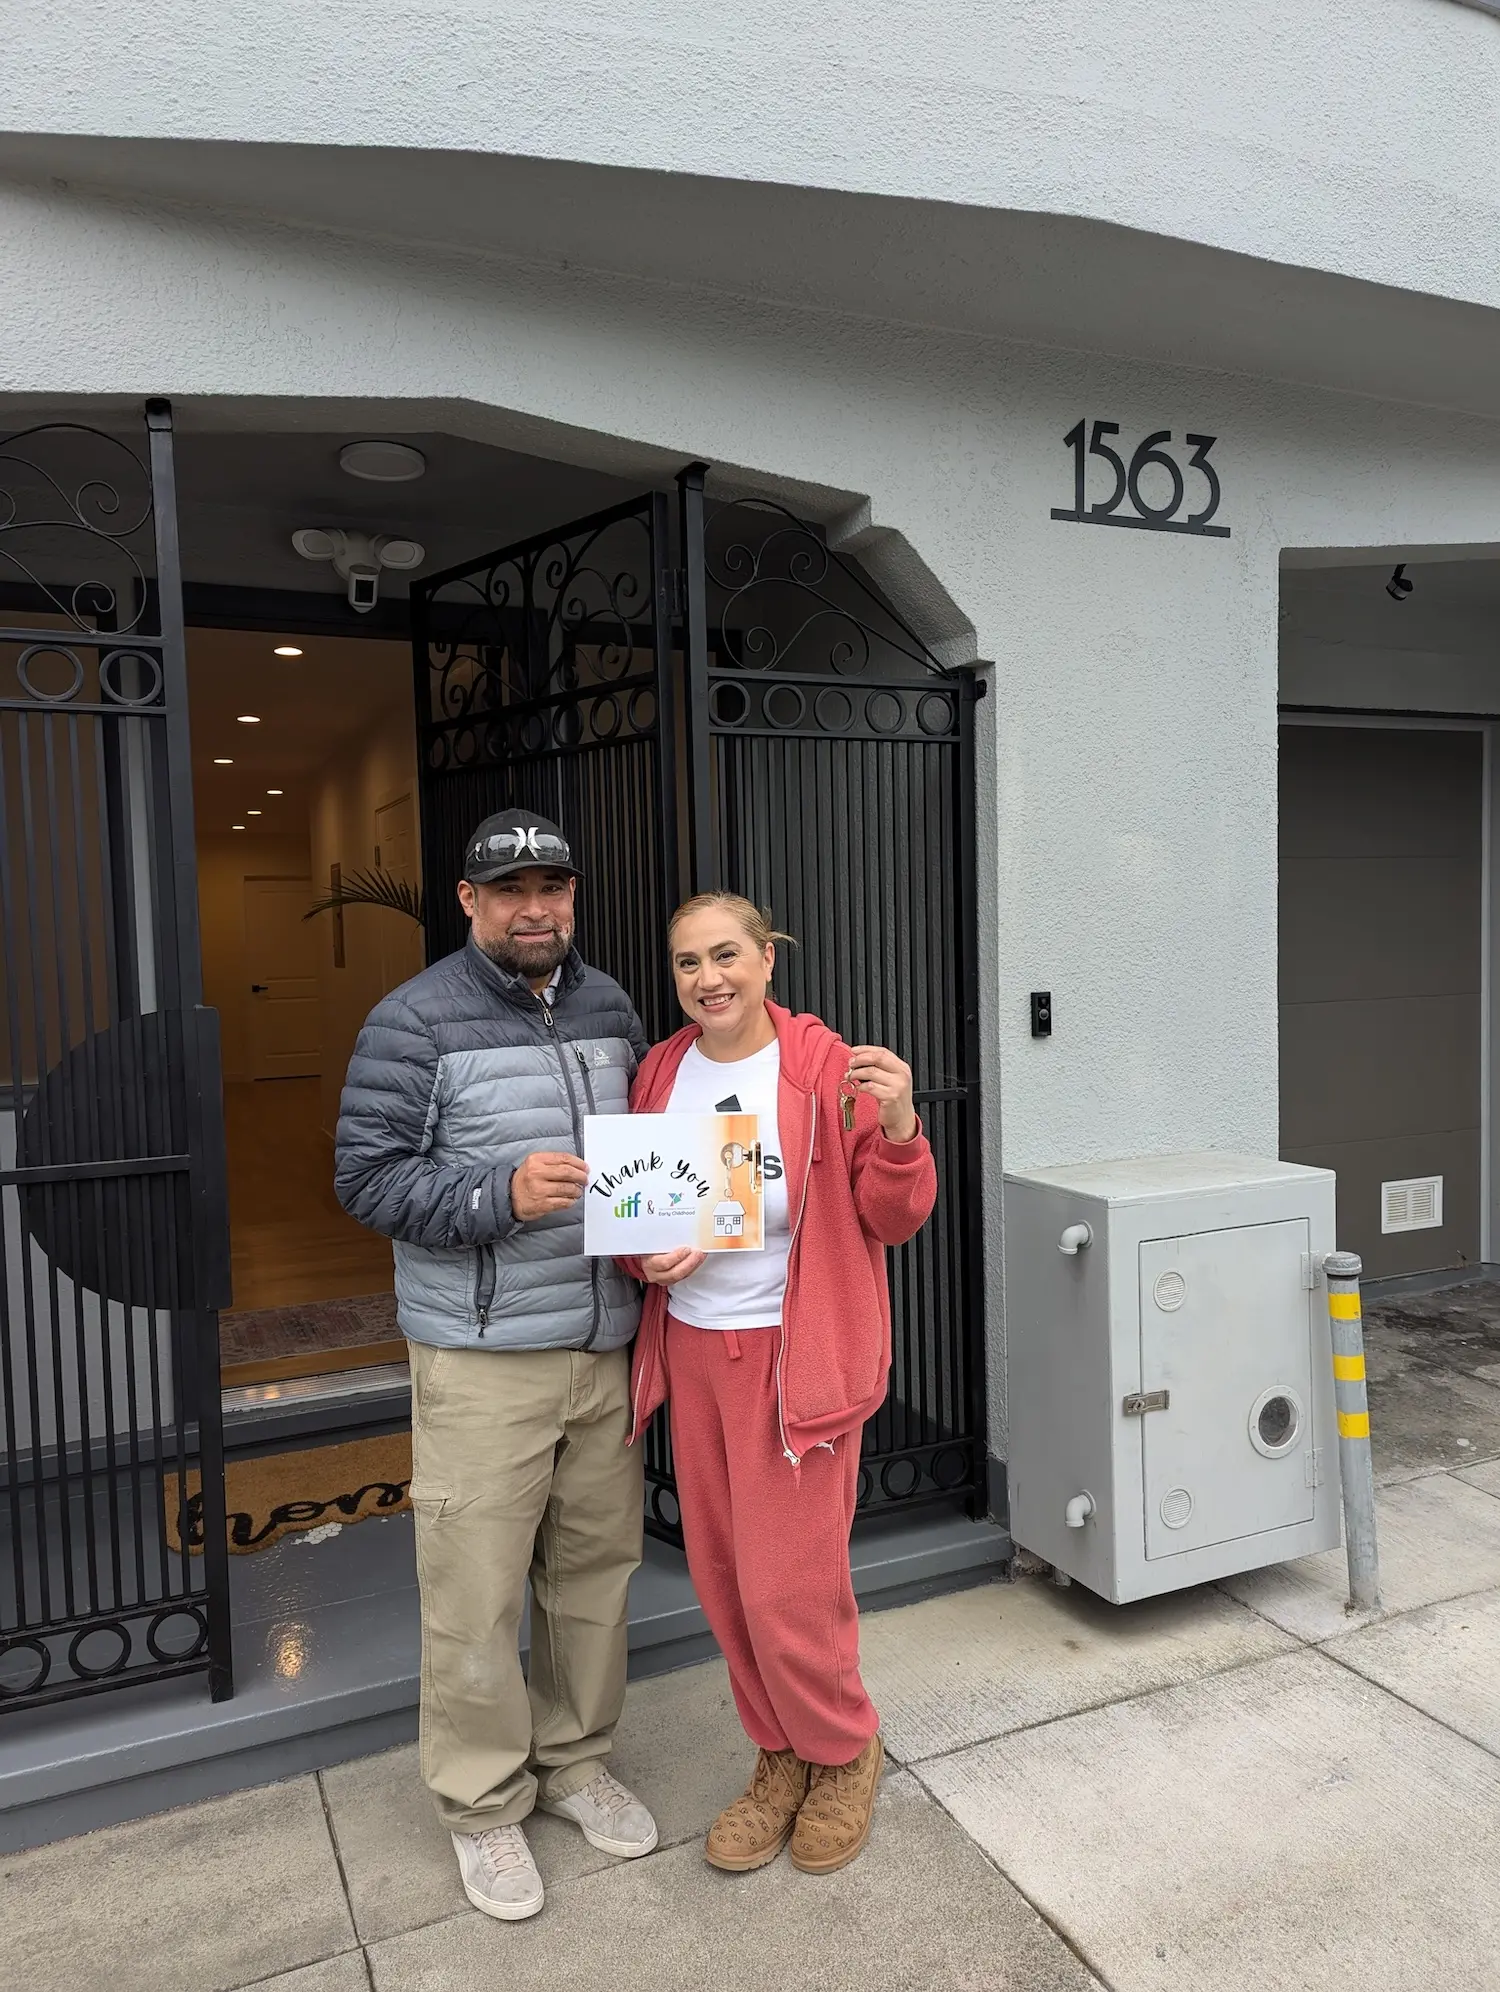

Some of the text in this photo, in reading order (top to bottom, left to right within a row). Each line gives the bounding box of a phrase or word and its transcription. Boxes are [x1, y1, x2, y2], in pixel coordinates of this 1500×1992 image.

[1063, 418, 1221, 526] 1563
[589, 1151, 710, 1198] Thank you
[646, 1199, 655, 1215] &
